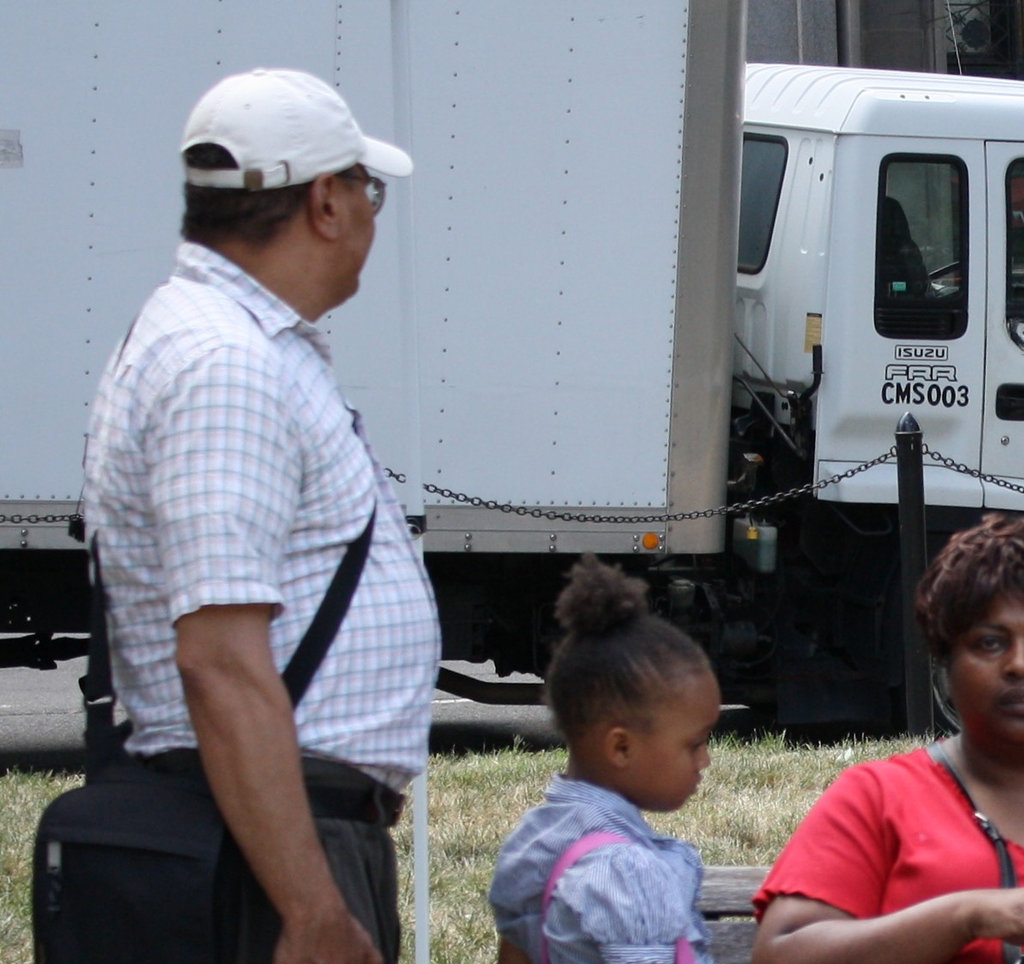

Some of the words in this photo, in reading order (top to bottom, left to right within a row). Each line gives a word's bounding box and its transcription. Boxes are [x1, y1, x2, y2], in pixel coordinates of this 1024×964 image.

[898, 347, 945, 358] ISUZU
[885, 364, 957, 381] FRR
[881, 382, 969, 408] CMS003
